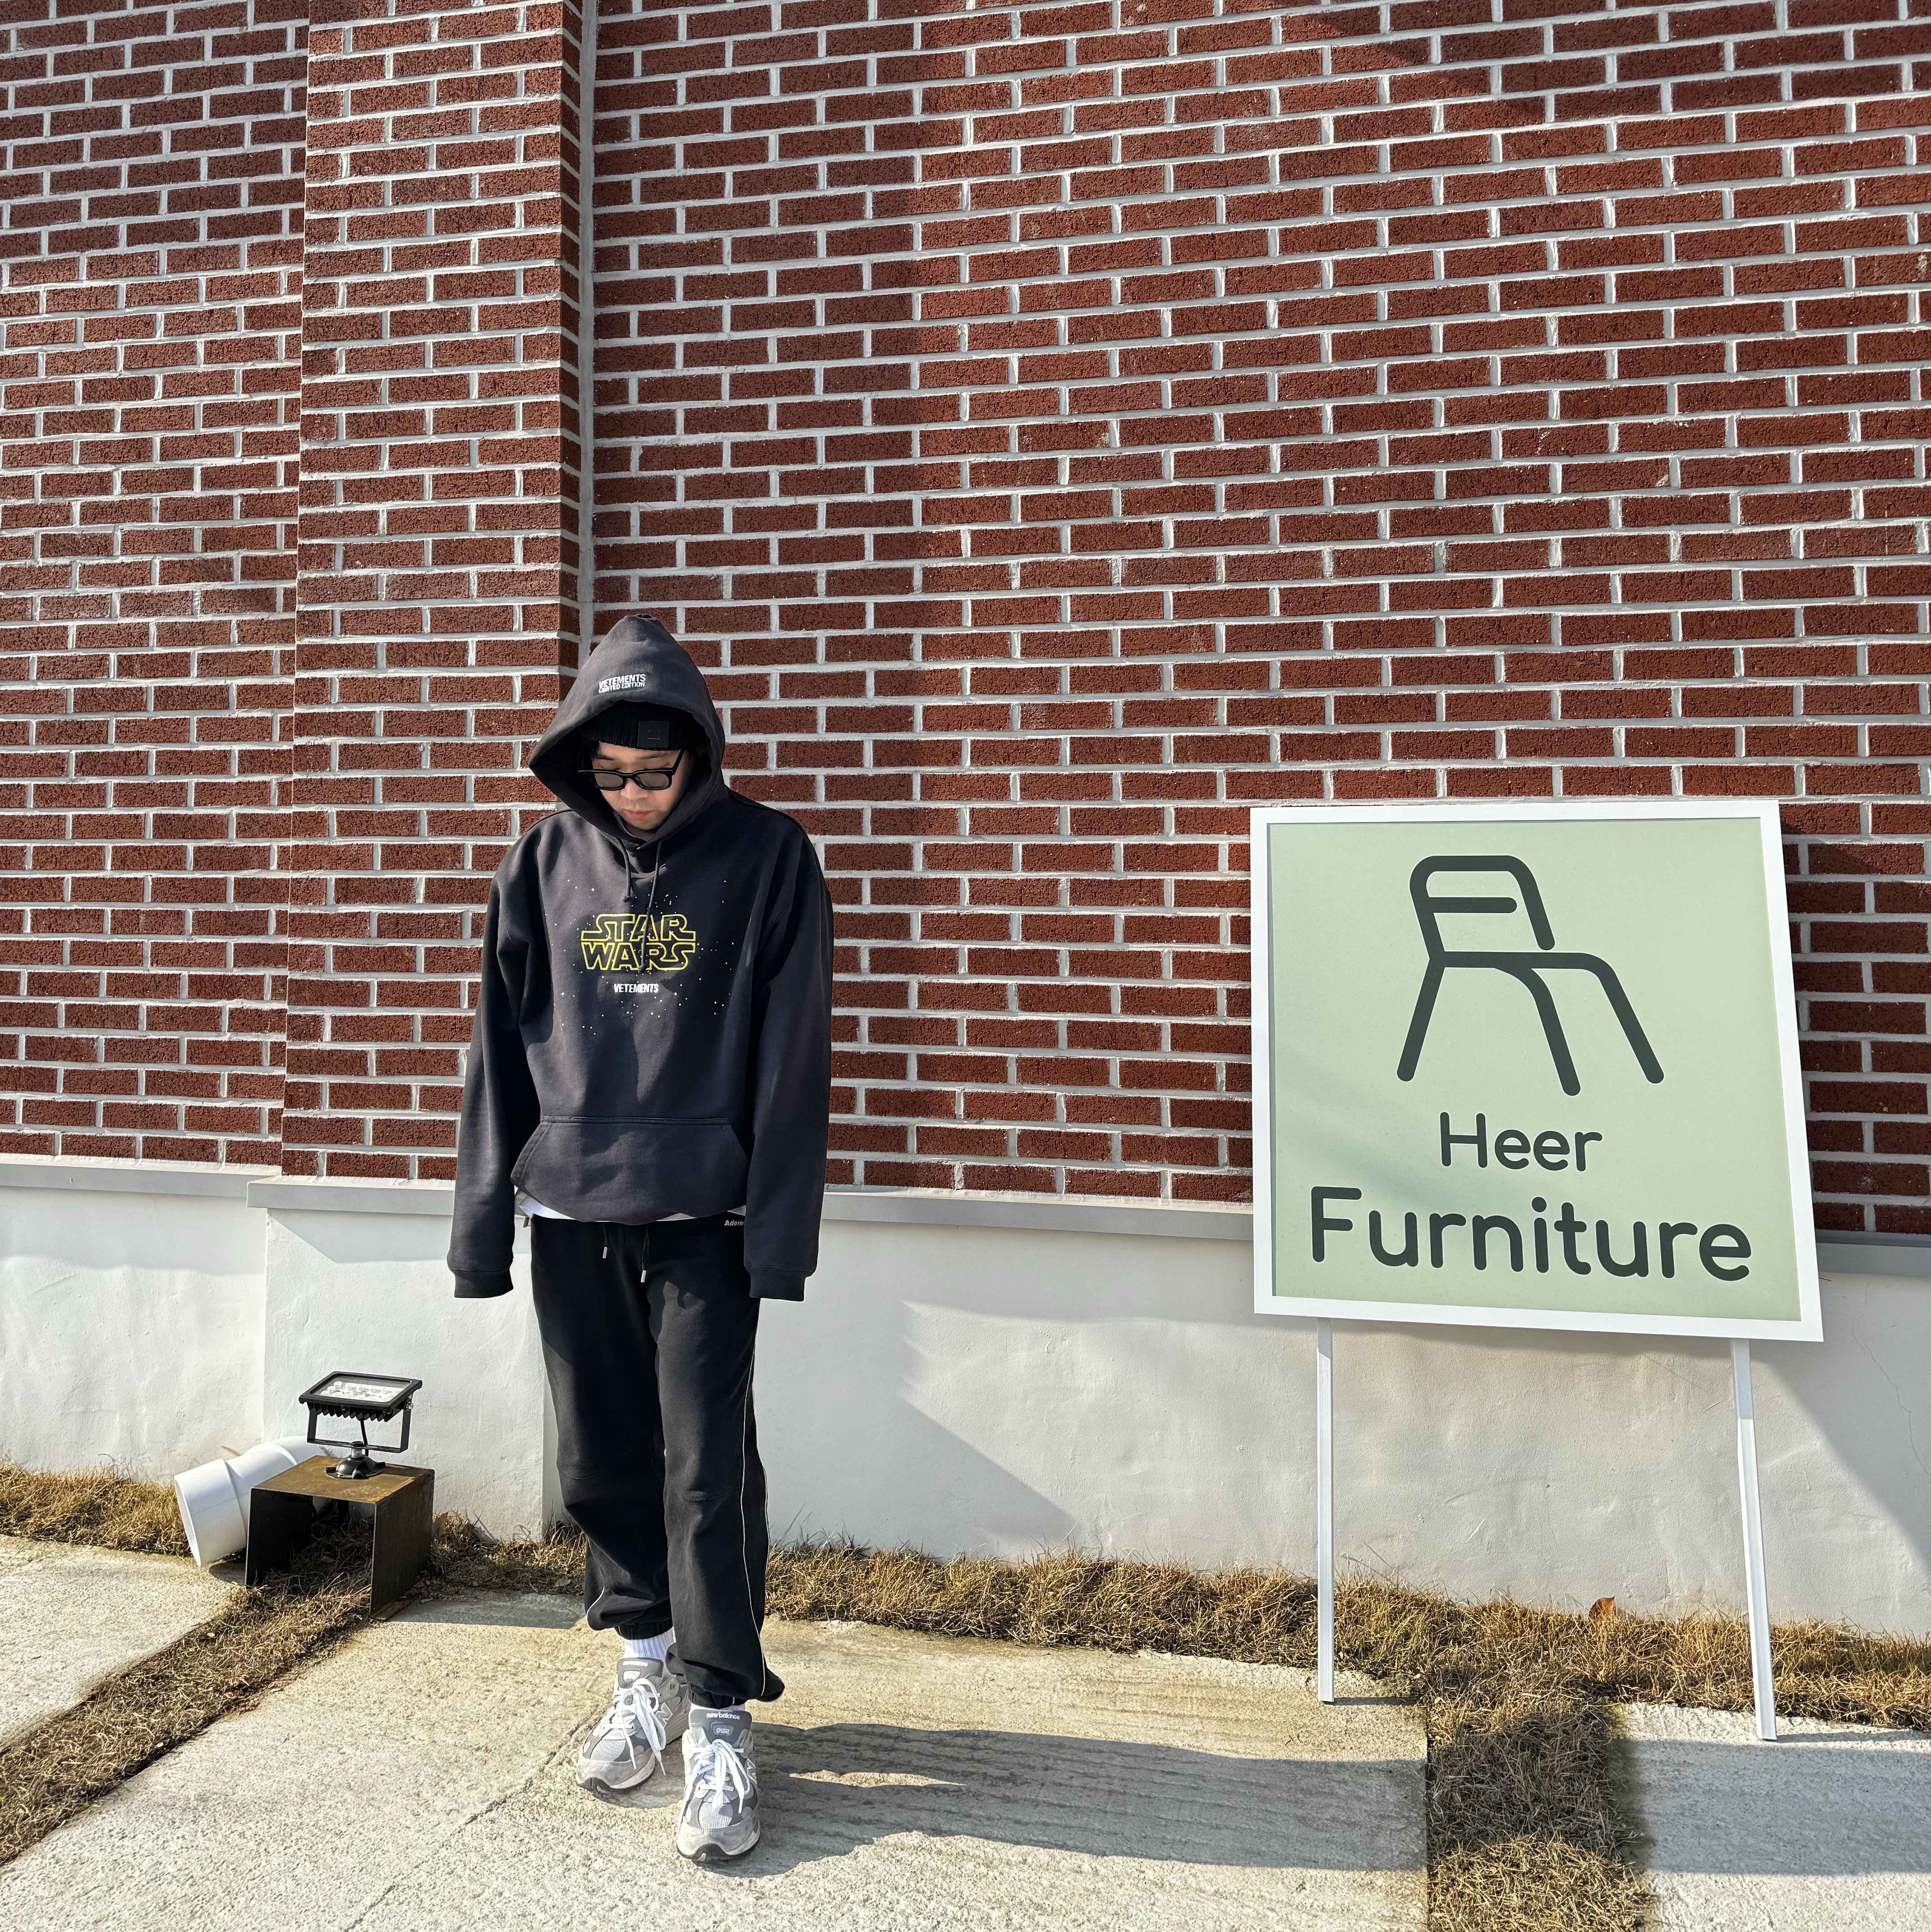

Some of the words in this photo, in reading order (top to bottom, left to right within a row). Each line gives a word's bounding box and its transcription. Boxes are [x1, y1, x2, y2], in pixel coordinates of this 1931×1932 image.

[599, 674, 646, 688] VETEMENTS
[581, 913, 696, 942] STAR
[581, 942, 696, 970] WARS
[614, 983, 659, 993] VETEMENTS
[1440, 1111, 1603, 1172] Heer
[1311, 1186, 1752, 1281] Furniture
[719, 1712, 740, 1720] balance
